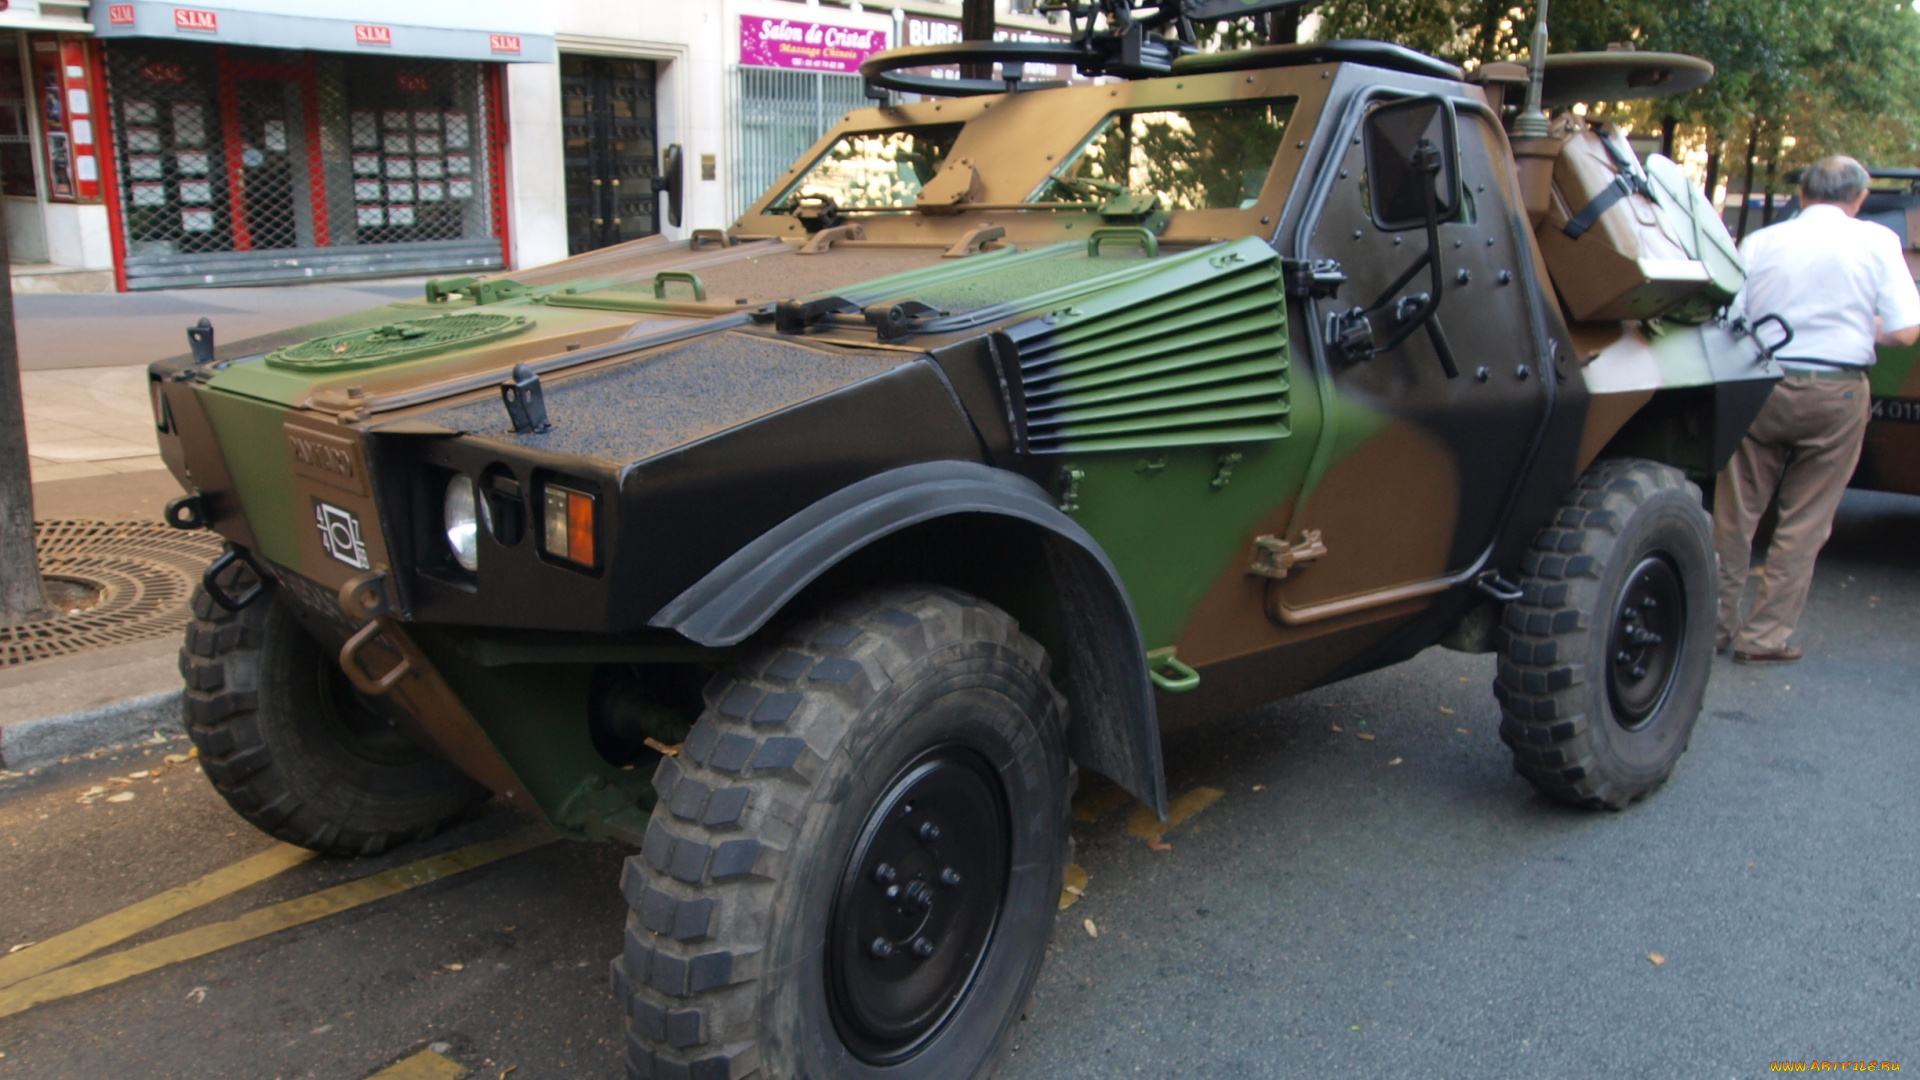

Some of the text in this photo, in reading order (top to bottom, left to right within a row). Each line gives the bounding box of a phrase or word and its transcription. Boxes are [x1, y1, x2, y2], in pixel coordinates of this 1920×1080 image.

[110, 6, 133, 21] S.I.M.
[177, 10, 214, 28] S.I.M.
[357, 26, 390, 42] S.I.M.
[758, 19, 872, 49] Salon de Cristal
[492, 36, 518, 50] S.I.M.
[779, 43, 821, 57] Massage
